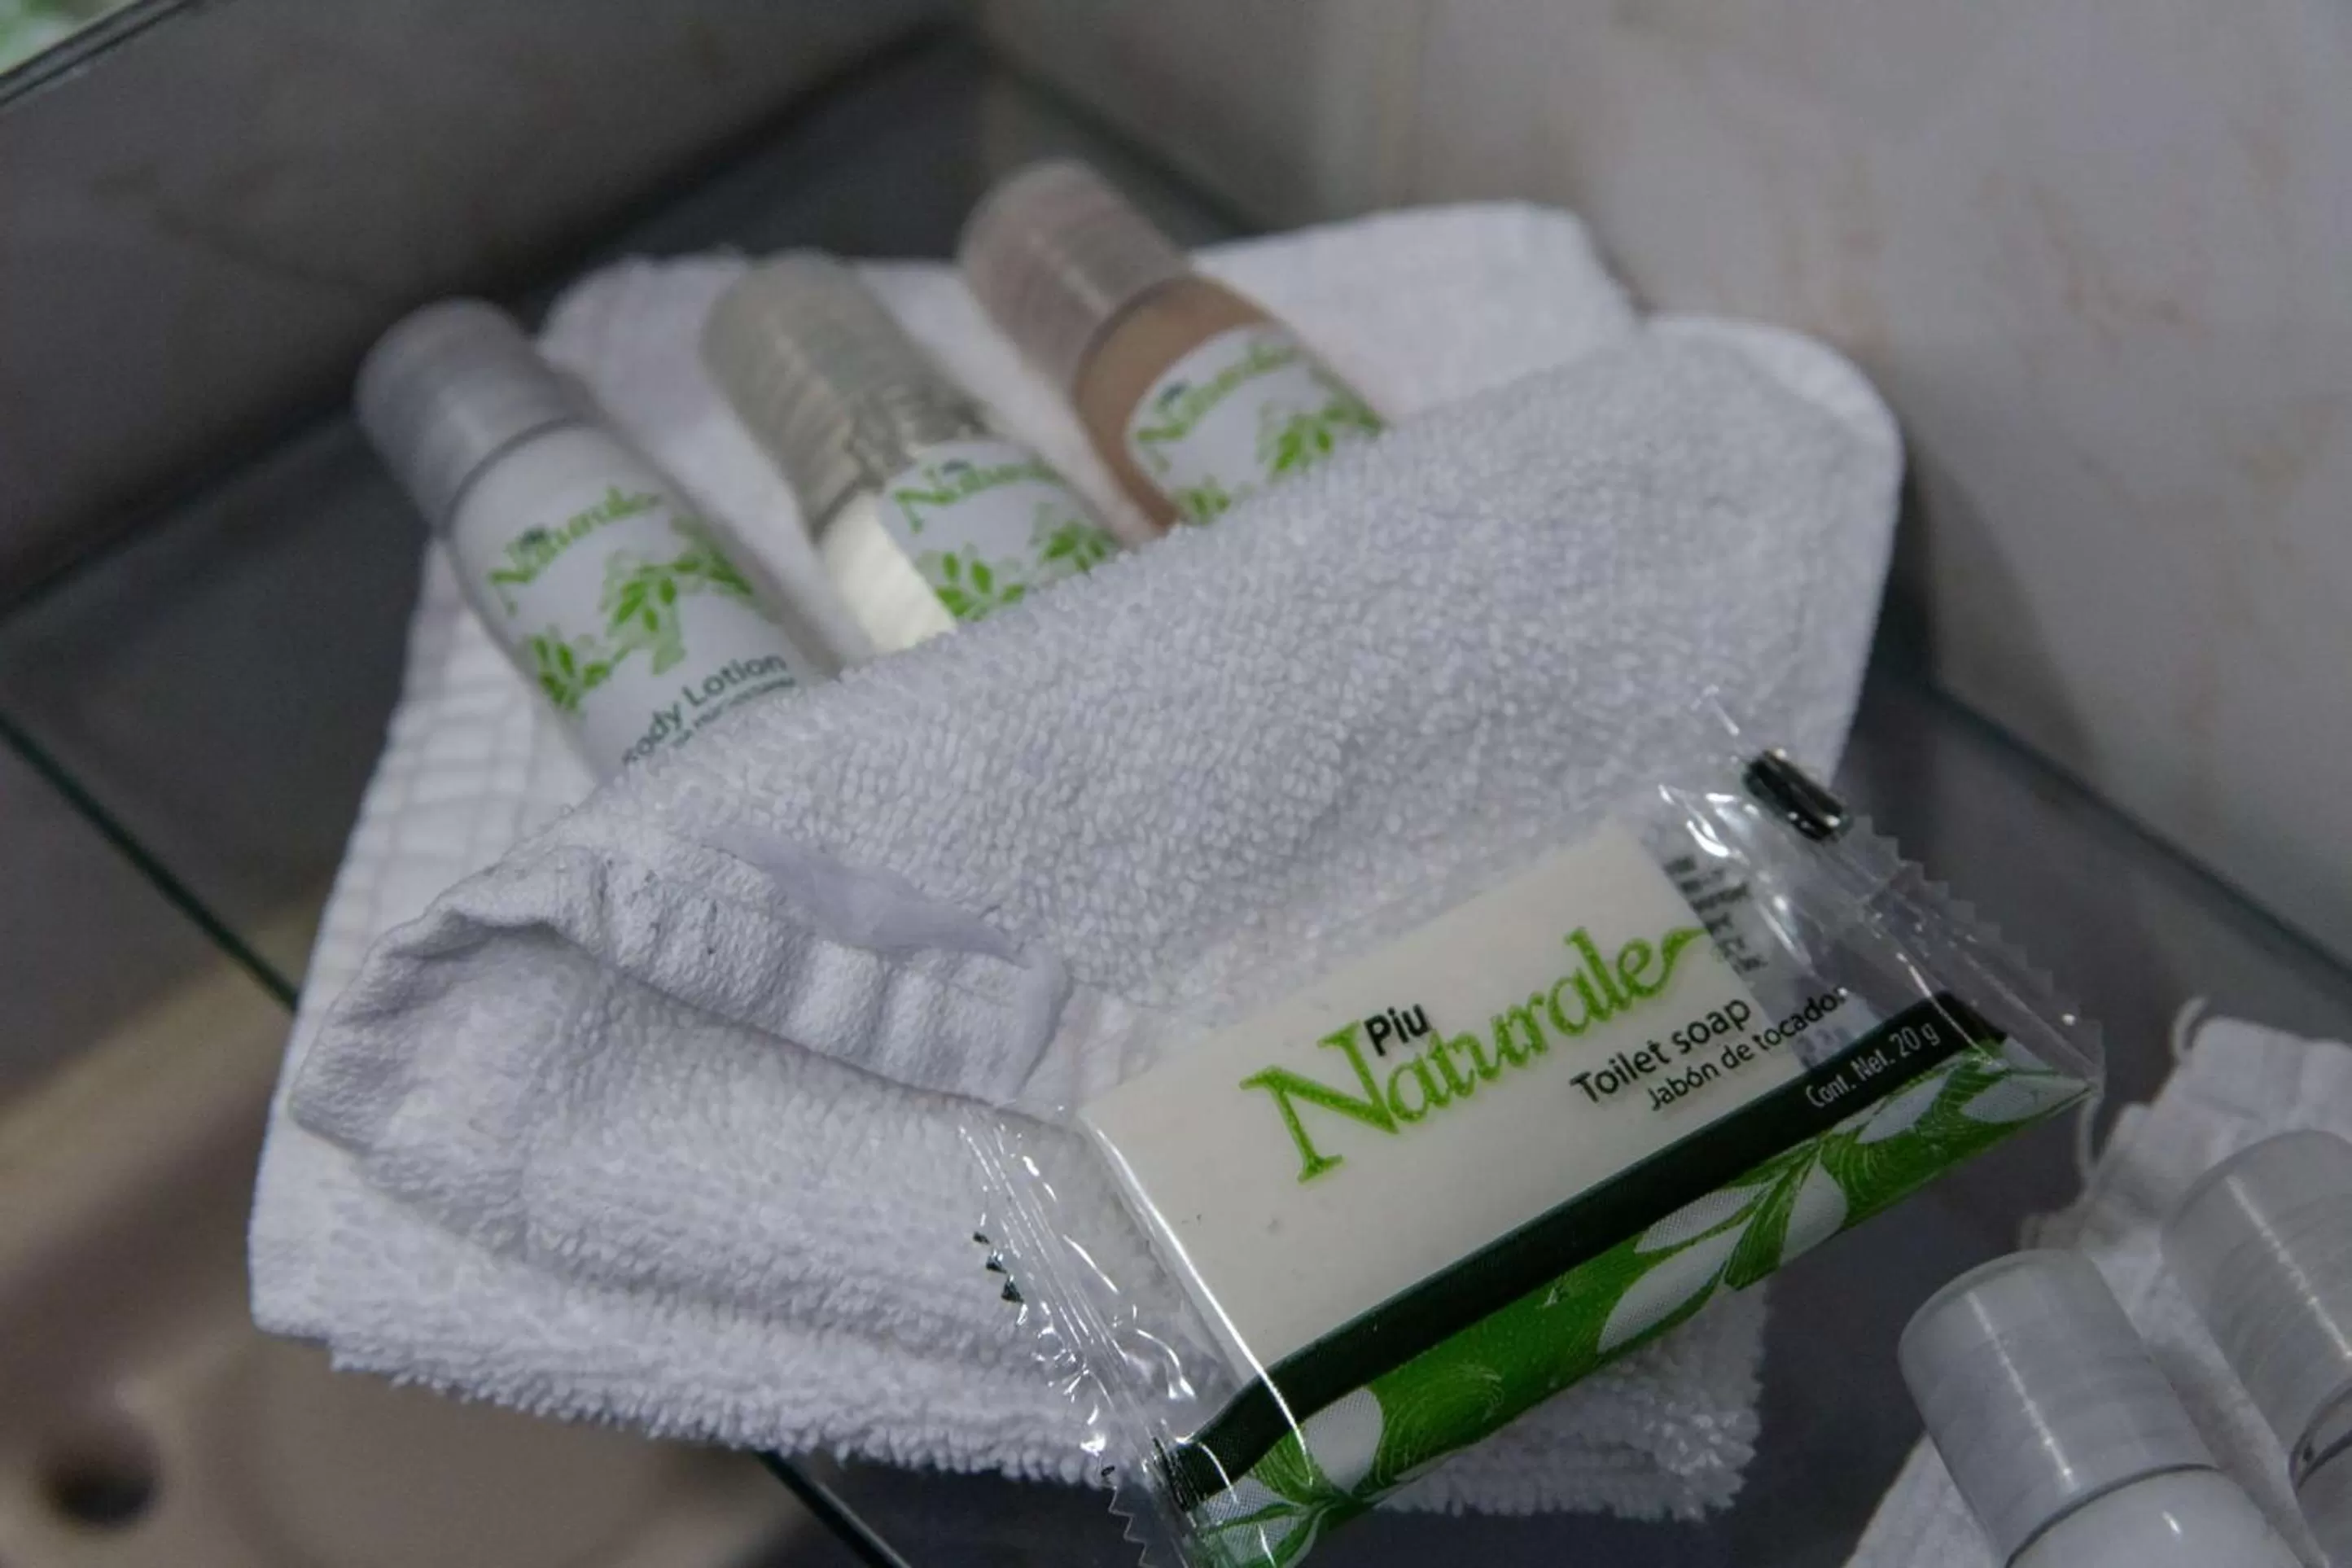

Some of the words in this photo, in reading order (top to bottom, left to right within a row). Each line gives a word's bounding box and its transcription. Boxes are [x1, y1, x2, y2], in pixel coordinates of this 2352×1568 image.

[681, 654, 787, 707] Lotion
[1239, 926, 1710, 1184] Naturale
[1363, 1003, 1430, 1058] Piu
[1570, 1039, 1671, 1105] Toilet
[1671, 998, 1751, 1055] soap
[1806, 1074, 1857, 1109] Cont.
[1850, 1048, 1896, 1082] Net.
[1888, 1026, 1921, 1058] 20
[1921, 1023, 1941, 1047] g
[1649, 1058, 1719, 1112] Jabón
[1720, 1041, 1755, 1070] de
